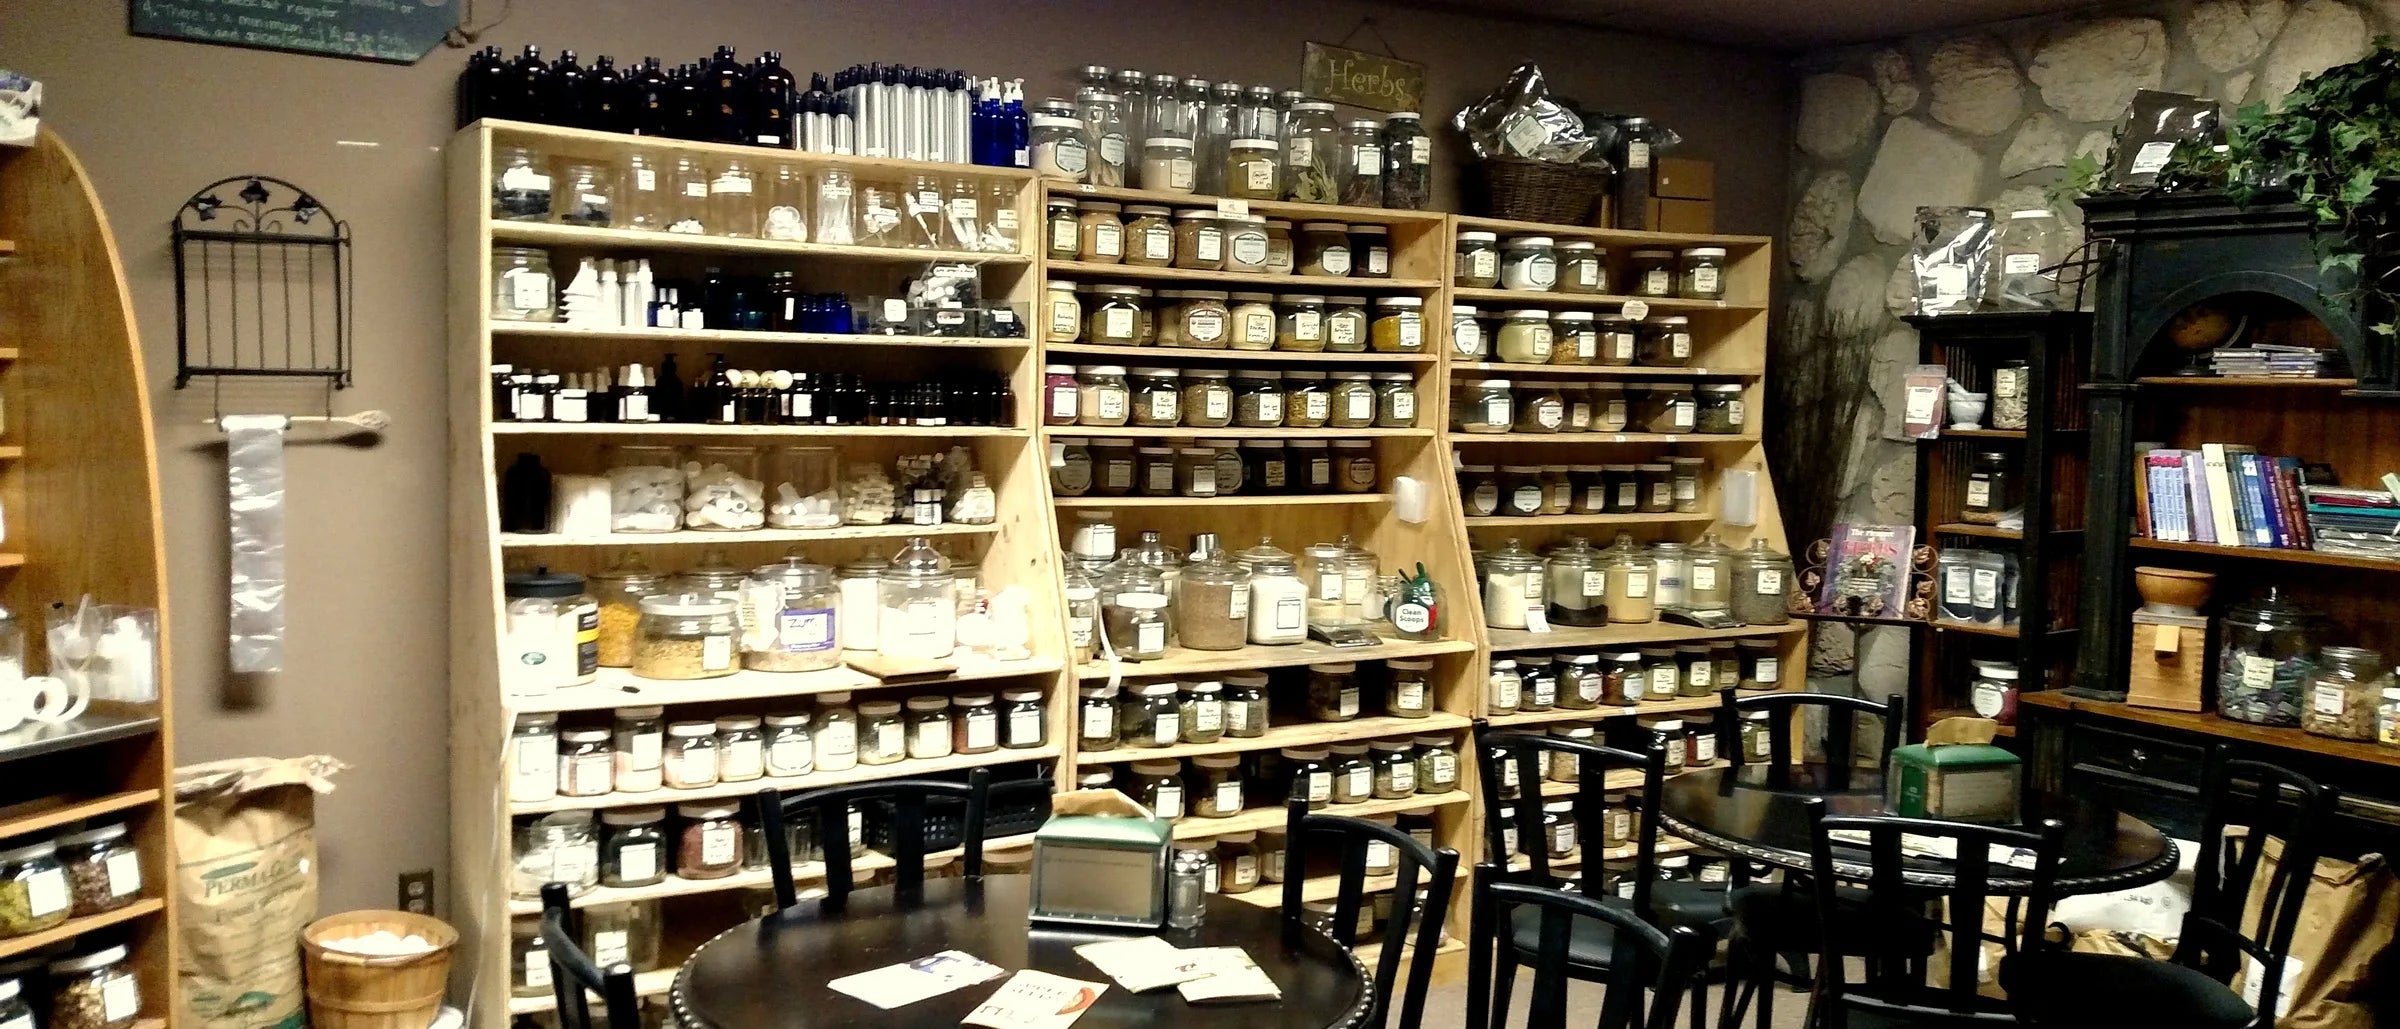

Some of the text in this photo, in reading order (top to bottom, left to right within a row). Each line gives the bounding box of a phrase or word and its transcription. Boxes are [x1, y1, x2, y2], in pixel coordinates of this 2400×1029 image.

[1324, 59, 1406, 101] Herbs
[1402, 608, 1422, 616] Clean
[1399, 615, 1425, 624] Scoops
